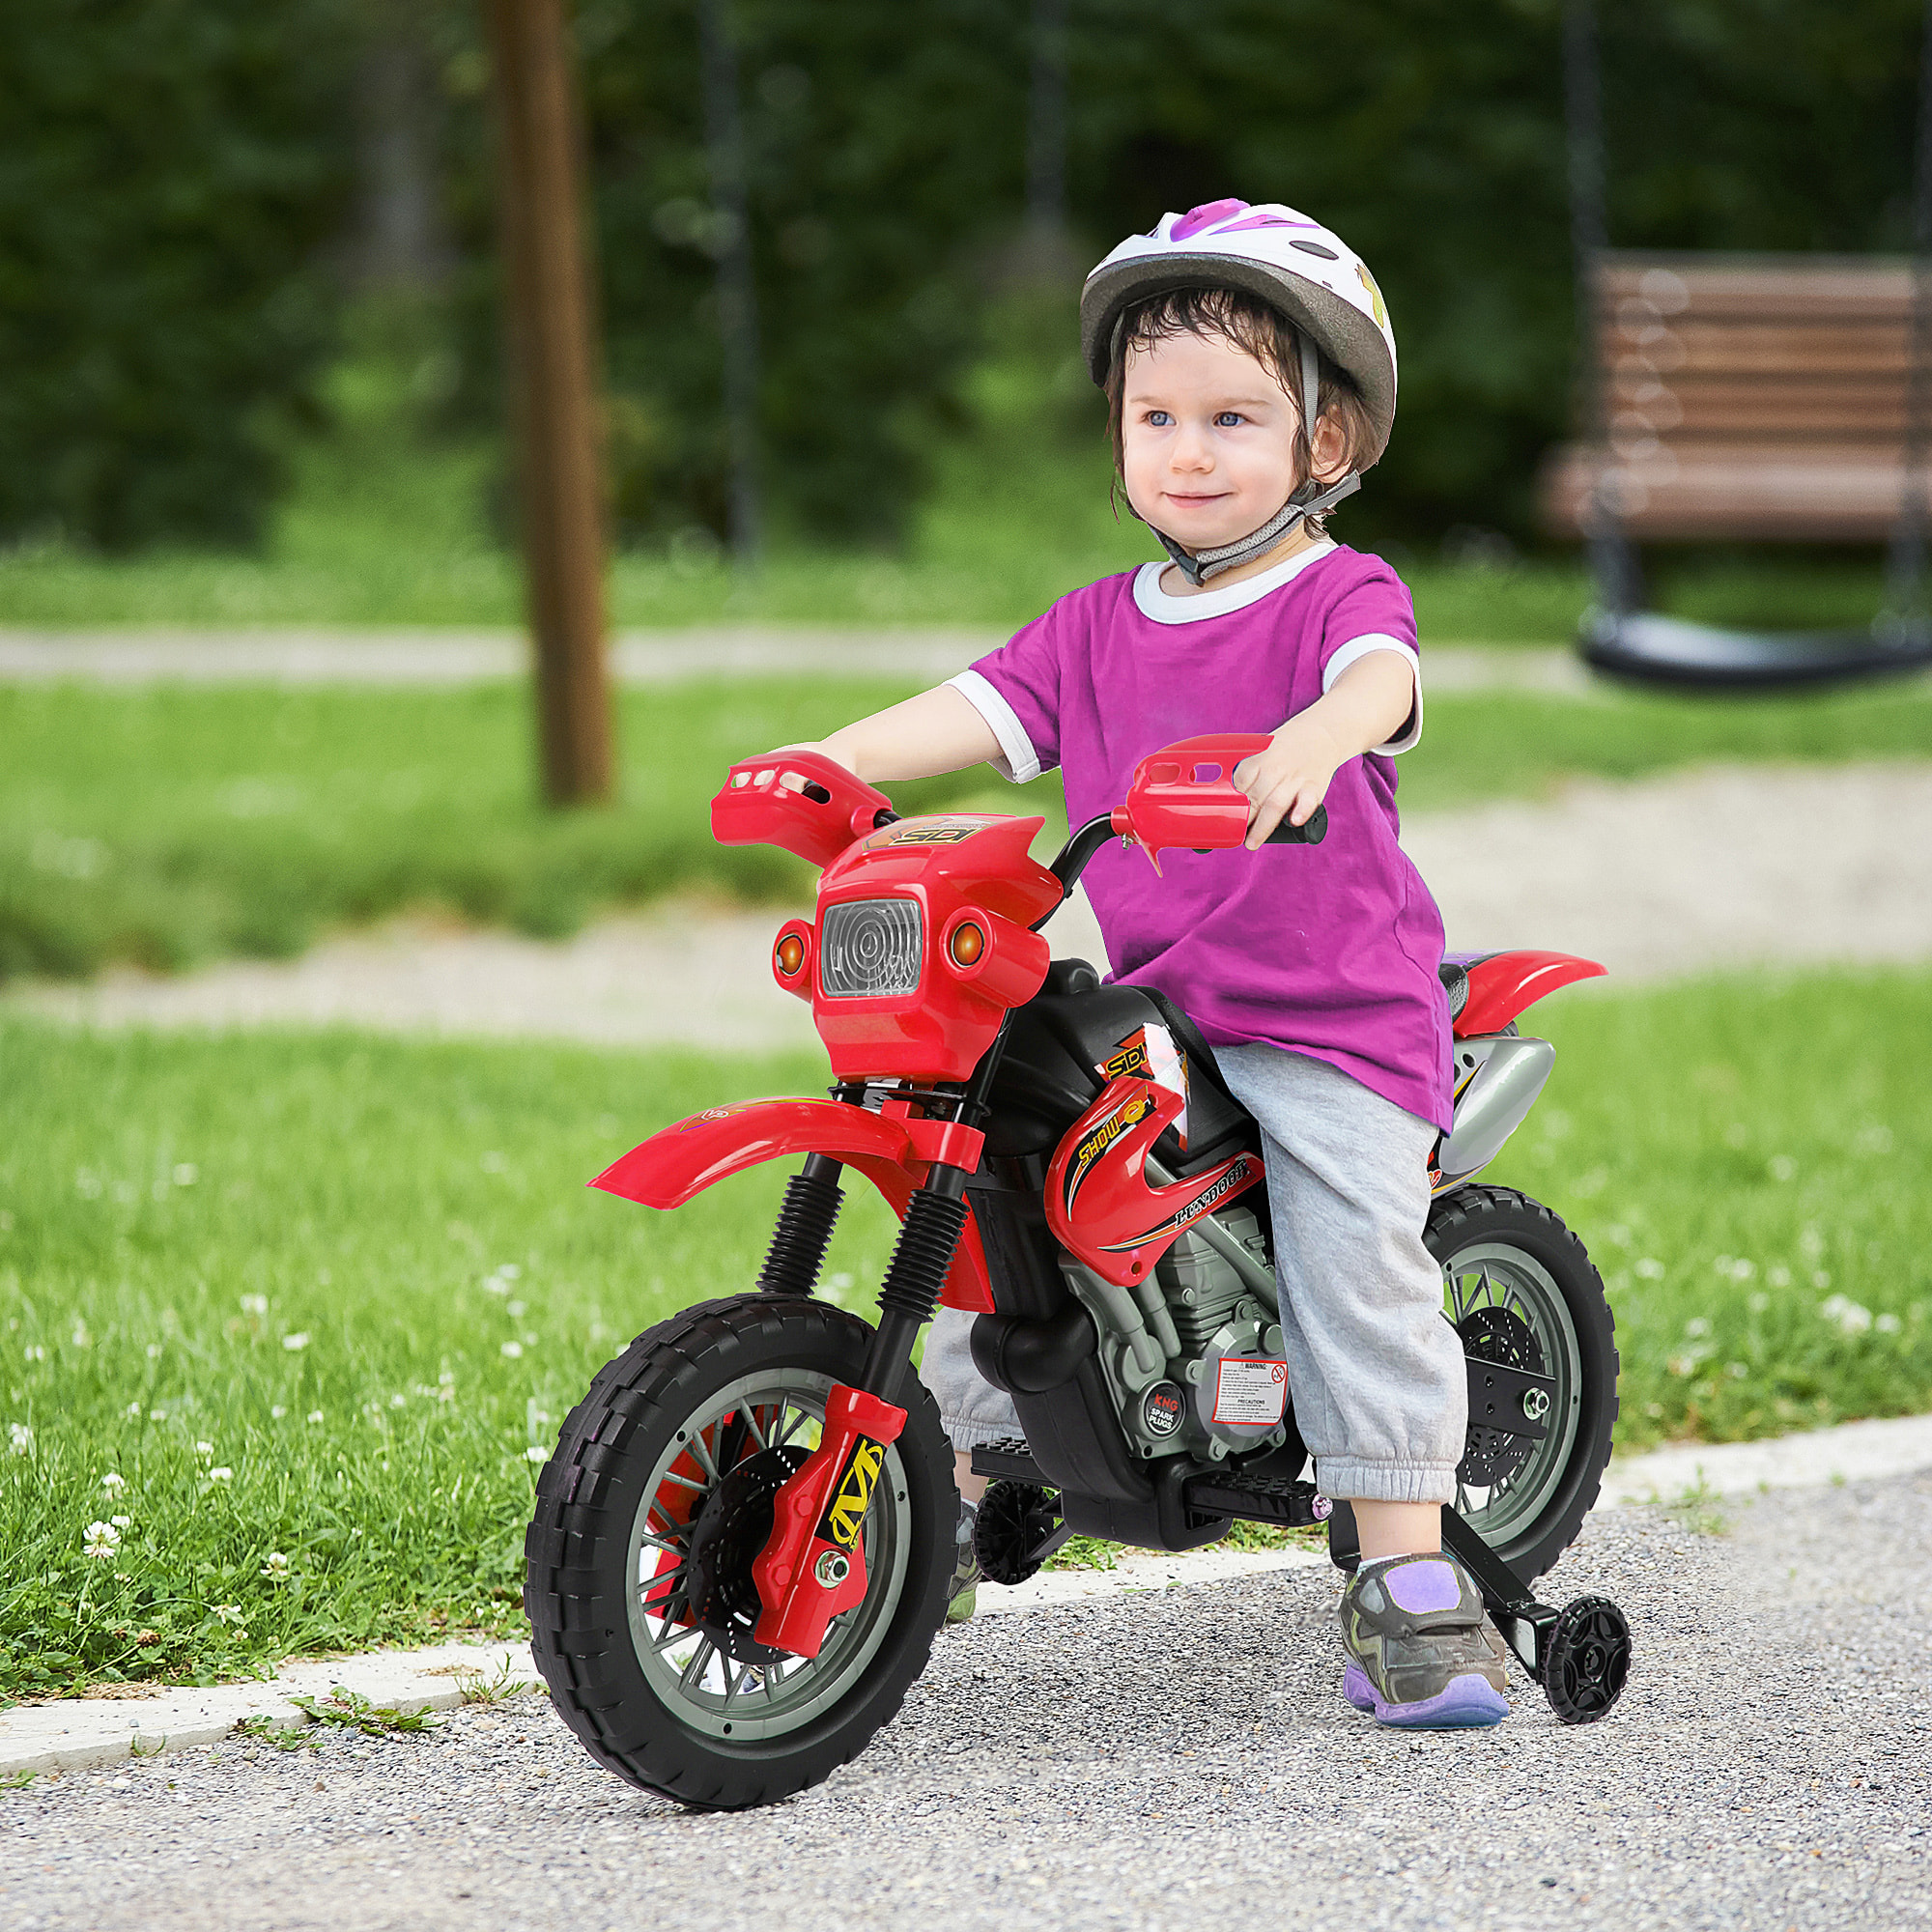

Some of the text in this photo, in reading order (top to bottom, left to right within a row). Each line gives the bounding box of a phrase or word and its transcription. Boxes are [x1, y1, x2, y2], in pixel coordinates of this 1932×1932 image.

[892, 828, 980, 845] SDI
[1106, 1042, 1148, 1080] SDI
[1078, 1116, 1121, 1167] SHOW
[1153, 1393, 1179, 1411] KNG
[1149, 1415, 1173, 1430] PLUGS
[1151, 1407, 1175, 1422] SPARK
